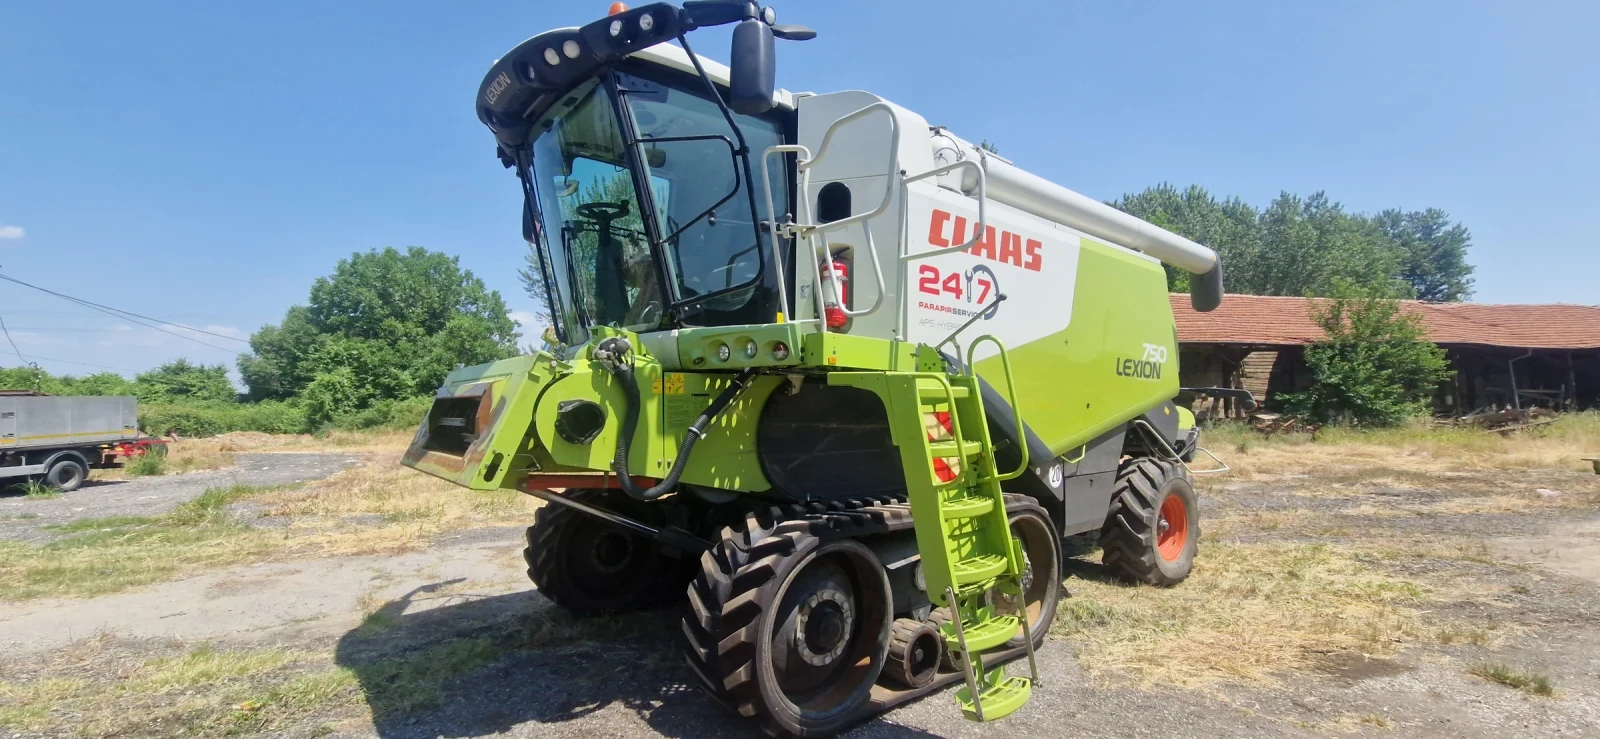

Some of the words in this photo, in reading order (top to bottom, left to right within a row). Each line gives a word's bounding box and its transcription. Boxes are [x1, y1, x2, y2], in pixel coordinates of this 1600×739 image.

[484, 71, 511, 105] LEXION
[928, 208, 1043, 272] CLAAS
[918, 264, 963, 300] 24
[976, 278, 991, 304] 7
[918, 301, 983, 320] PARAPIRSERVIC
[918, 318, 935, 328] APS
[1142, 342, 1167, 364] 750
[1116, 357, 1161, 380] LEXION
